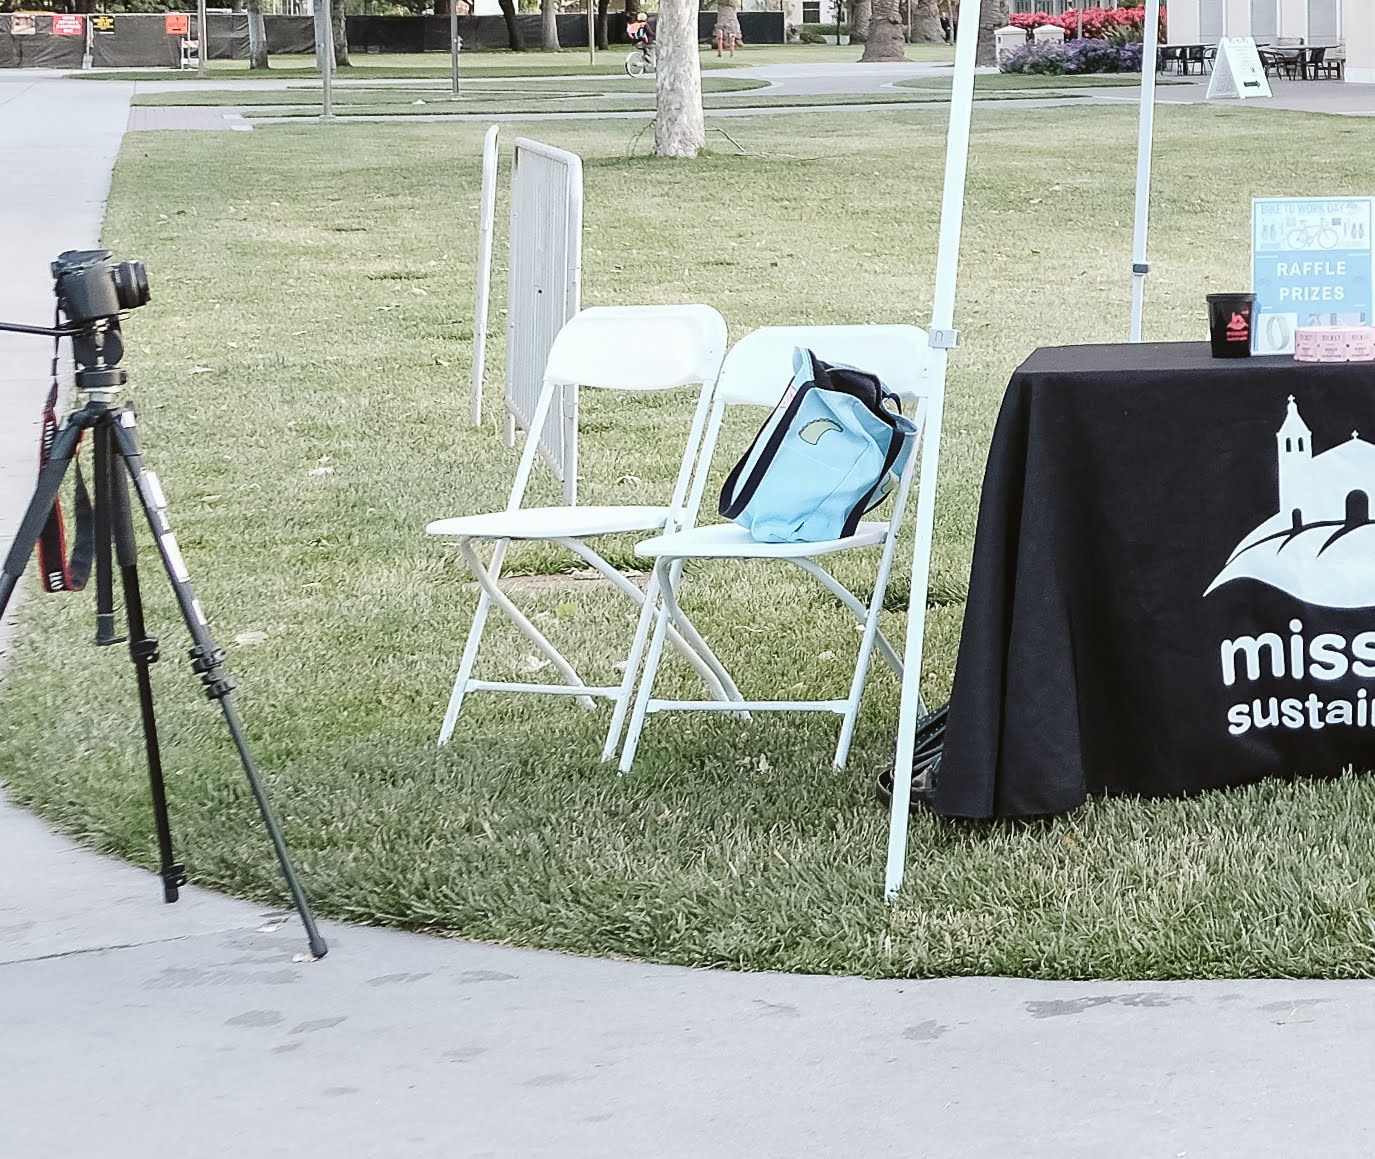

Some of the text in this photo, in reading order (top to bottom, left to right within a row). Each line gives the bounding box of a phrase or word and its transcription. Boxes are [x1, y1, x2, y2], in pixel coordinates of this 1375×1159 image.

[1285, 203, 1296, 214] TO
[1299, 203, 1326, 214] WORK
[1327, 202, 1344, 213] DAY
[1277, 261, 1347, 277] RAFFLE
[1279, 286, 1345, 301] PRIZES
